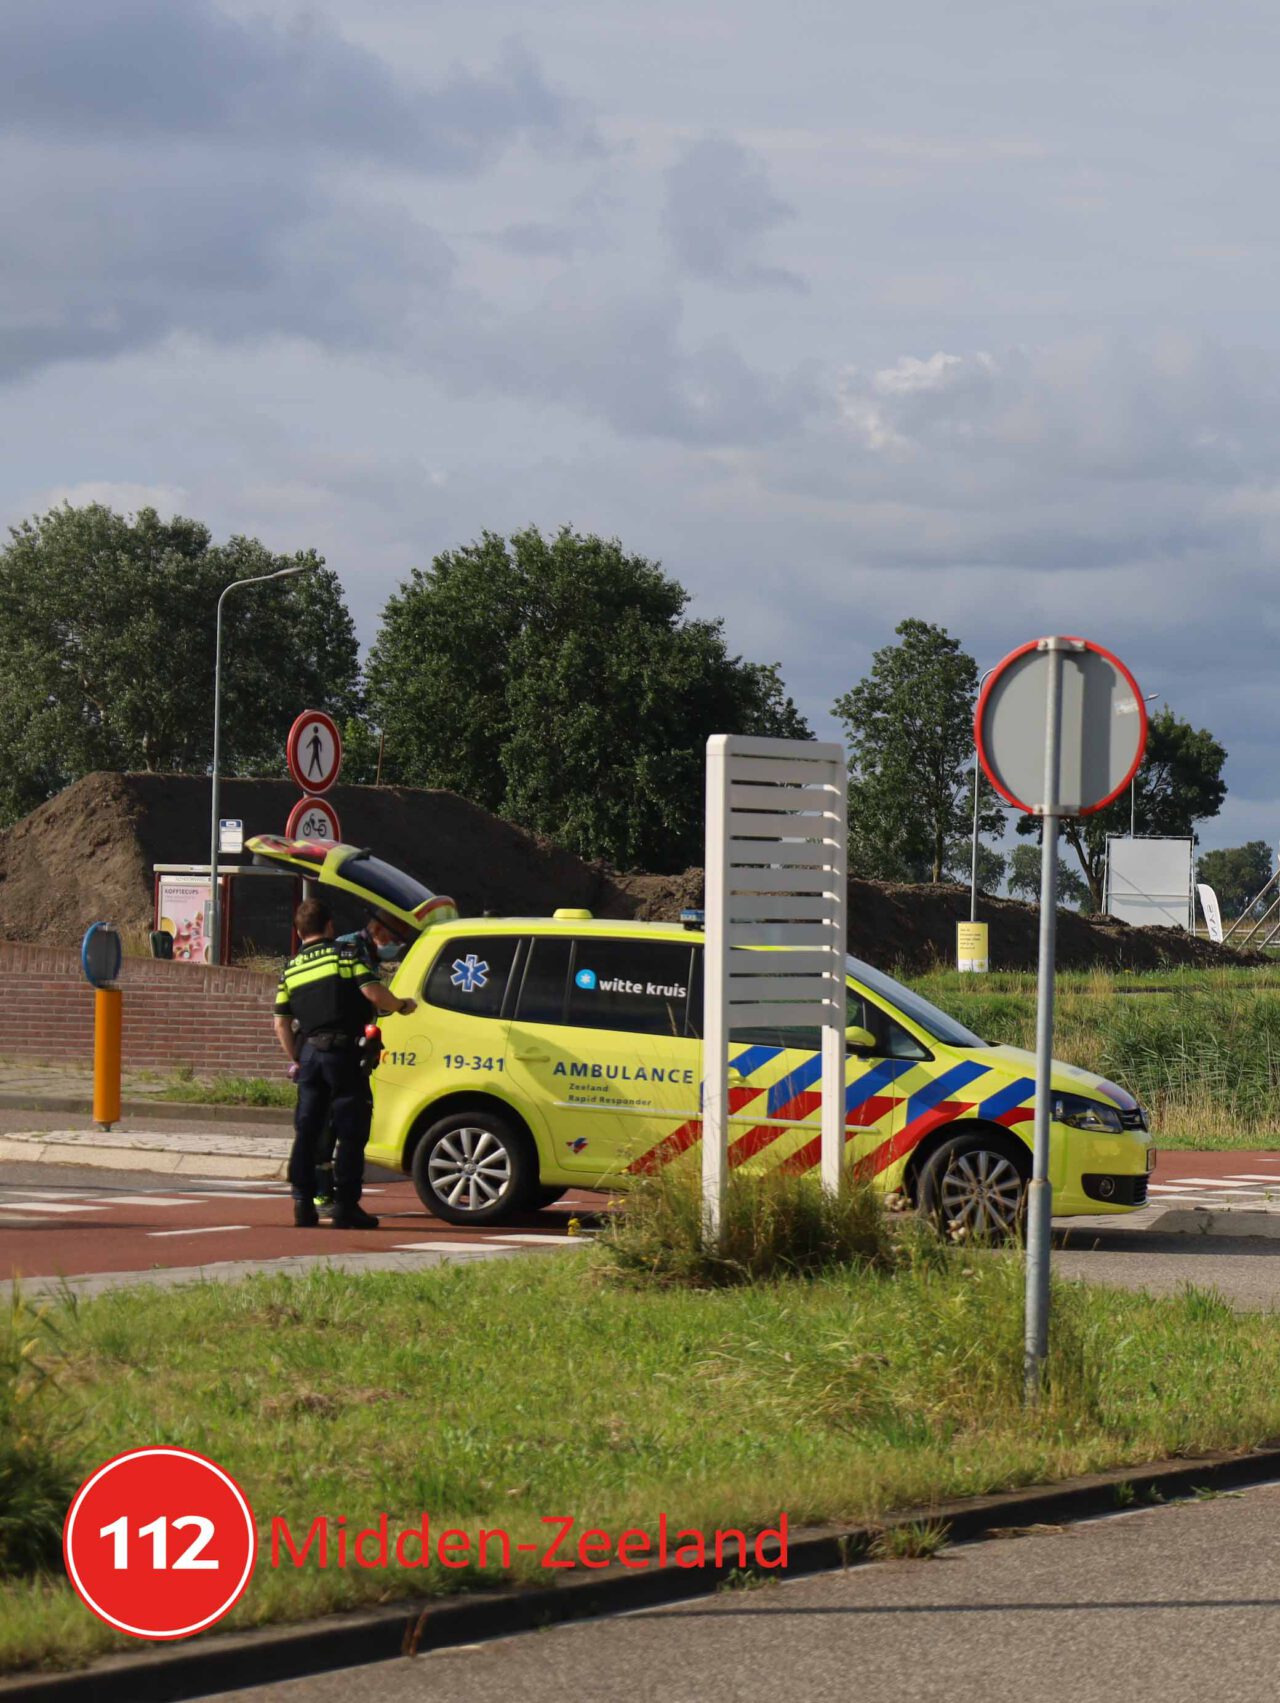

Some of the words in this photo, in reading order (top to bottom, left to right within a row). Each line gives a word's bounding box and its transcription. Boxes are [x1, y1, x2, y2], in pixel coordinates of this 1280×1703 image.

[599, 978, 643, 994] witte
[646, 982, 687, 998] kruis
[443, 1054, 505, 1072] 19-341
[553, 1061, 694, 1084] AMBULANCE
[568, 1083, 609, 1092] Zeeland
[568, 1094, 597, 1103] Rapid
[599, 1096, 652, 1106] Responder
